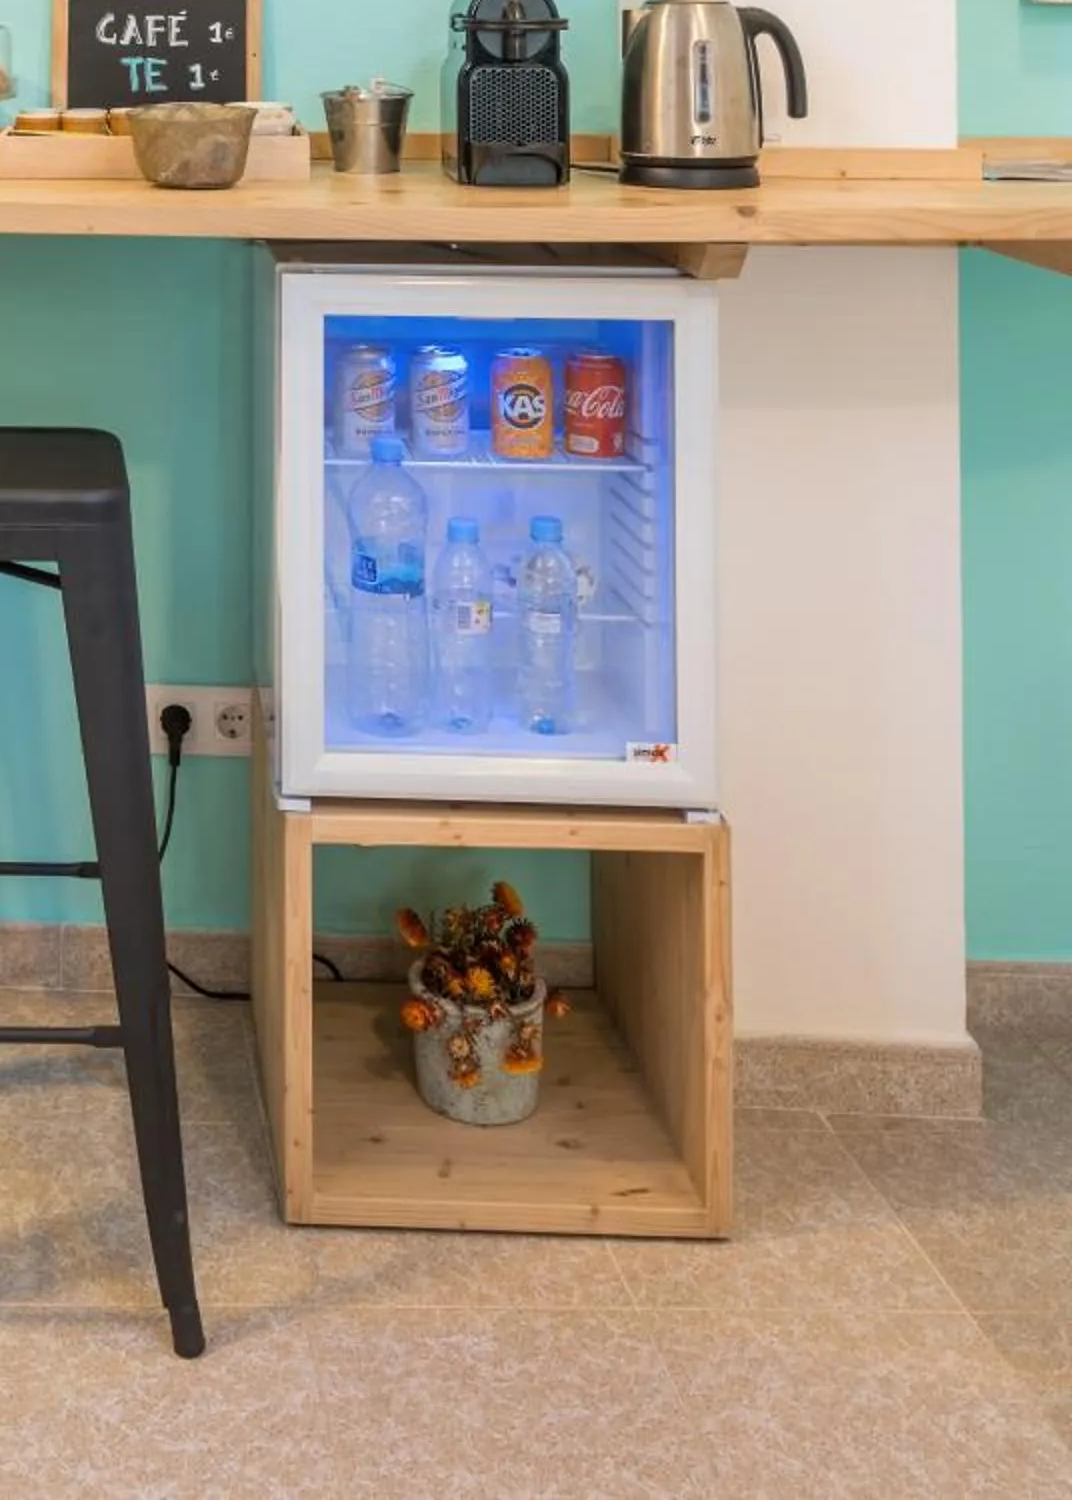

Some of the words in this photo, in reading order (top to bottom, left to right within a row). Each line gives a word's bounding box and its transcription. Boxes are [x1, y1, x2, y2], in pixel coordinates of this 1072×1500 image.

[95, 9, 189, 48] CAFÉ
[119, 56, 169, 93] TE
[497, 392, 546, 417] KAS
